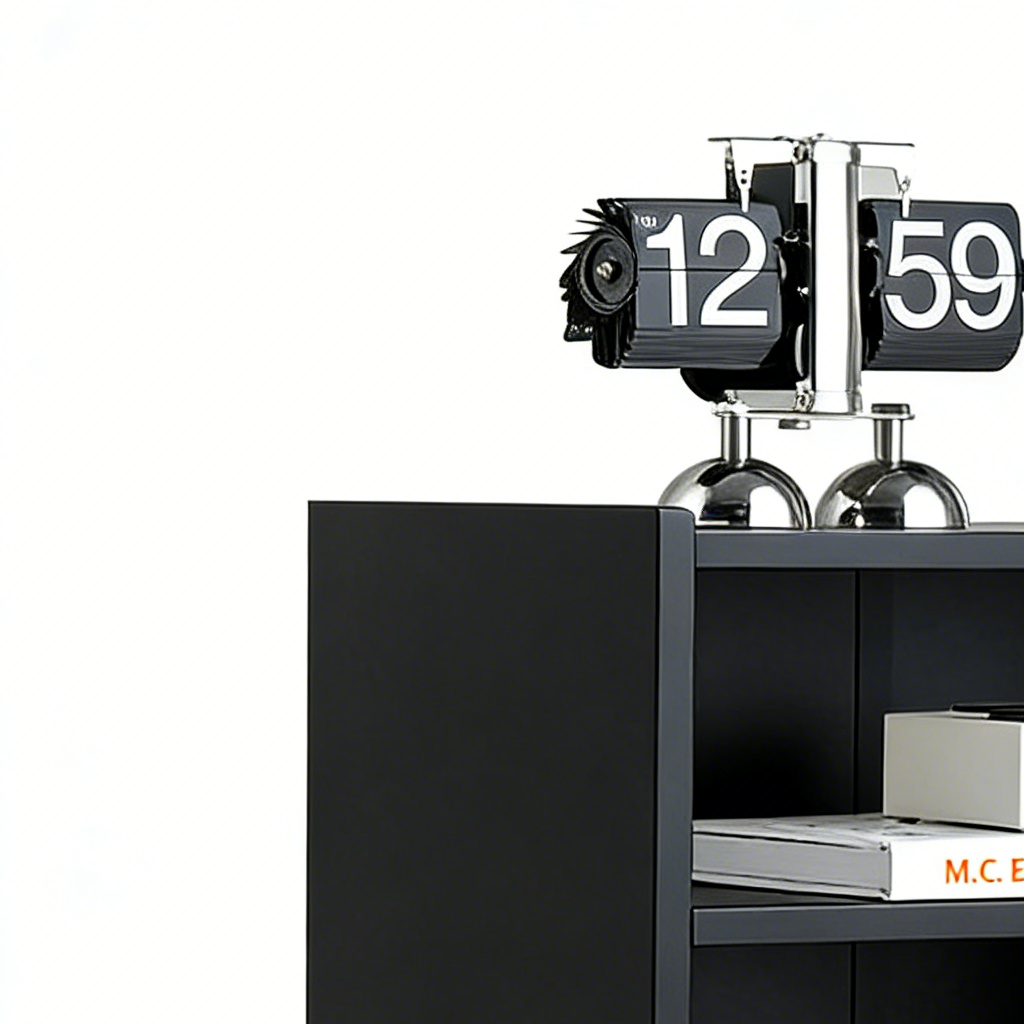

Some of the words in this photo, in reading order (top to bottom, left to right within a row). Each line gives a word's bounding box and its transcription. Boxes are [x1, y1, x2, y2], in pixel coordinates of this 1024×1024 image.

[646, 214, 768, 326] 12
[885, 220, 1016, 330] 59
[945, 857, 1003, 885] M.C.
